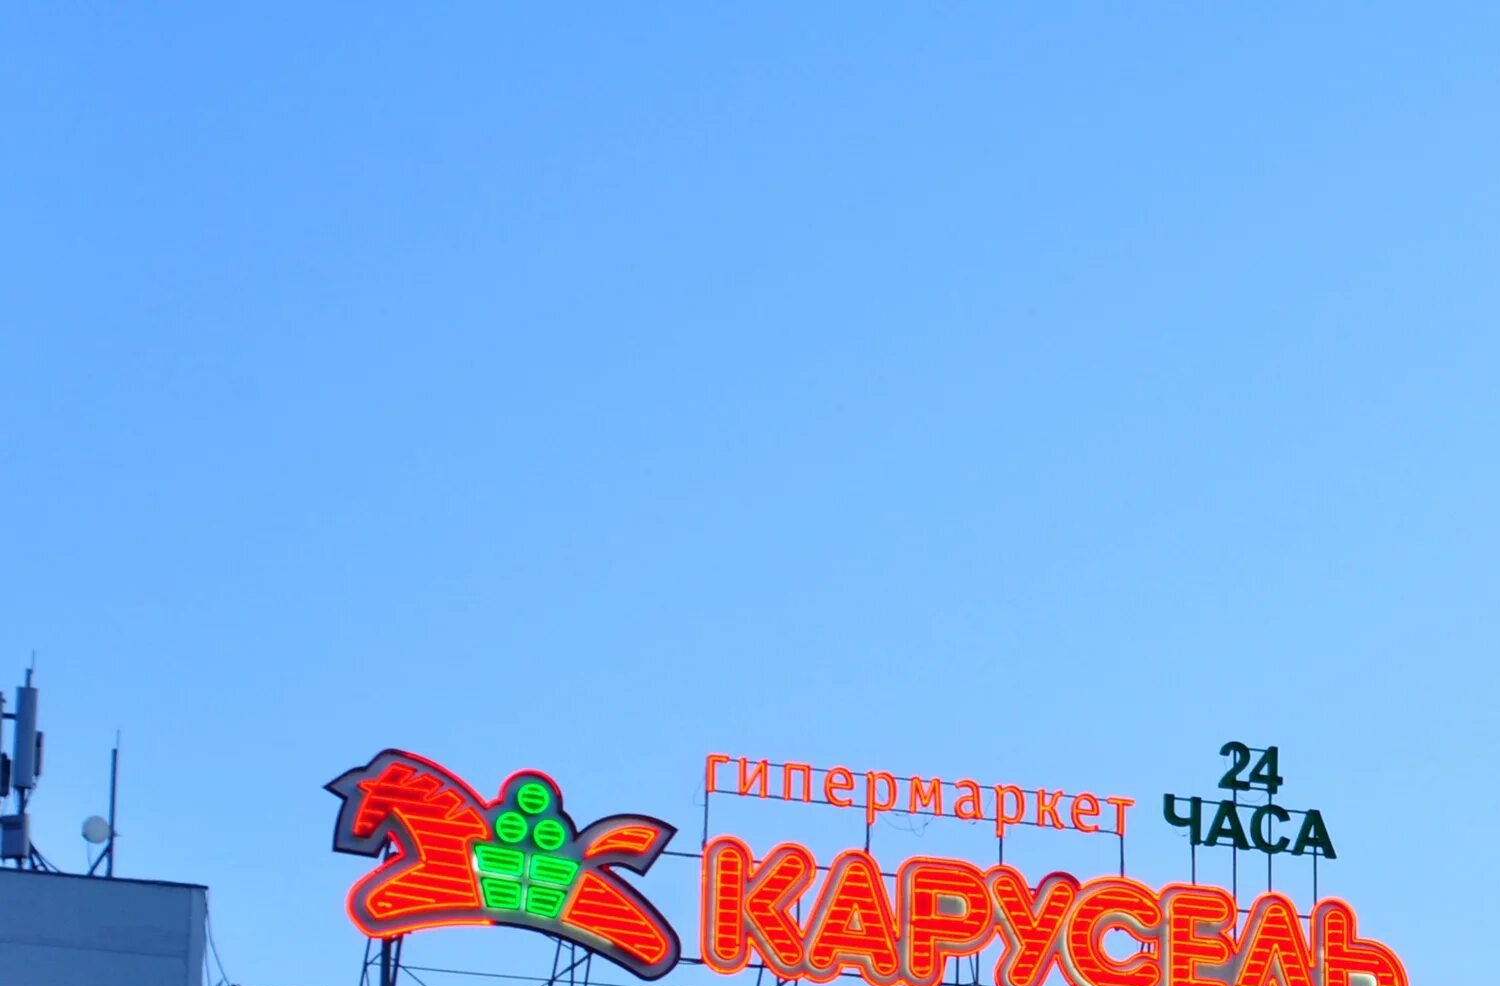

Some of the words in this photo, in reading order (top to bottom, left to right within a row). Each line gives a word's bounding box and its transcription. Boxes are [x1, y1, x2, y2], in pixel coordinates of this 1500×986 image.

[705, 753, 1136, 838] гипермаркет
[1219, 741, 1285, 795] 24
[1162, 793, 1338, 860] ЧАСА
